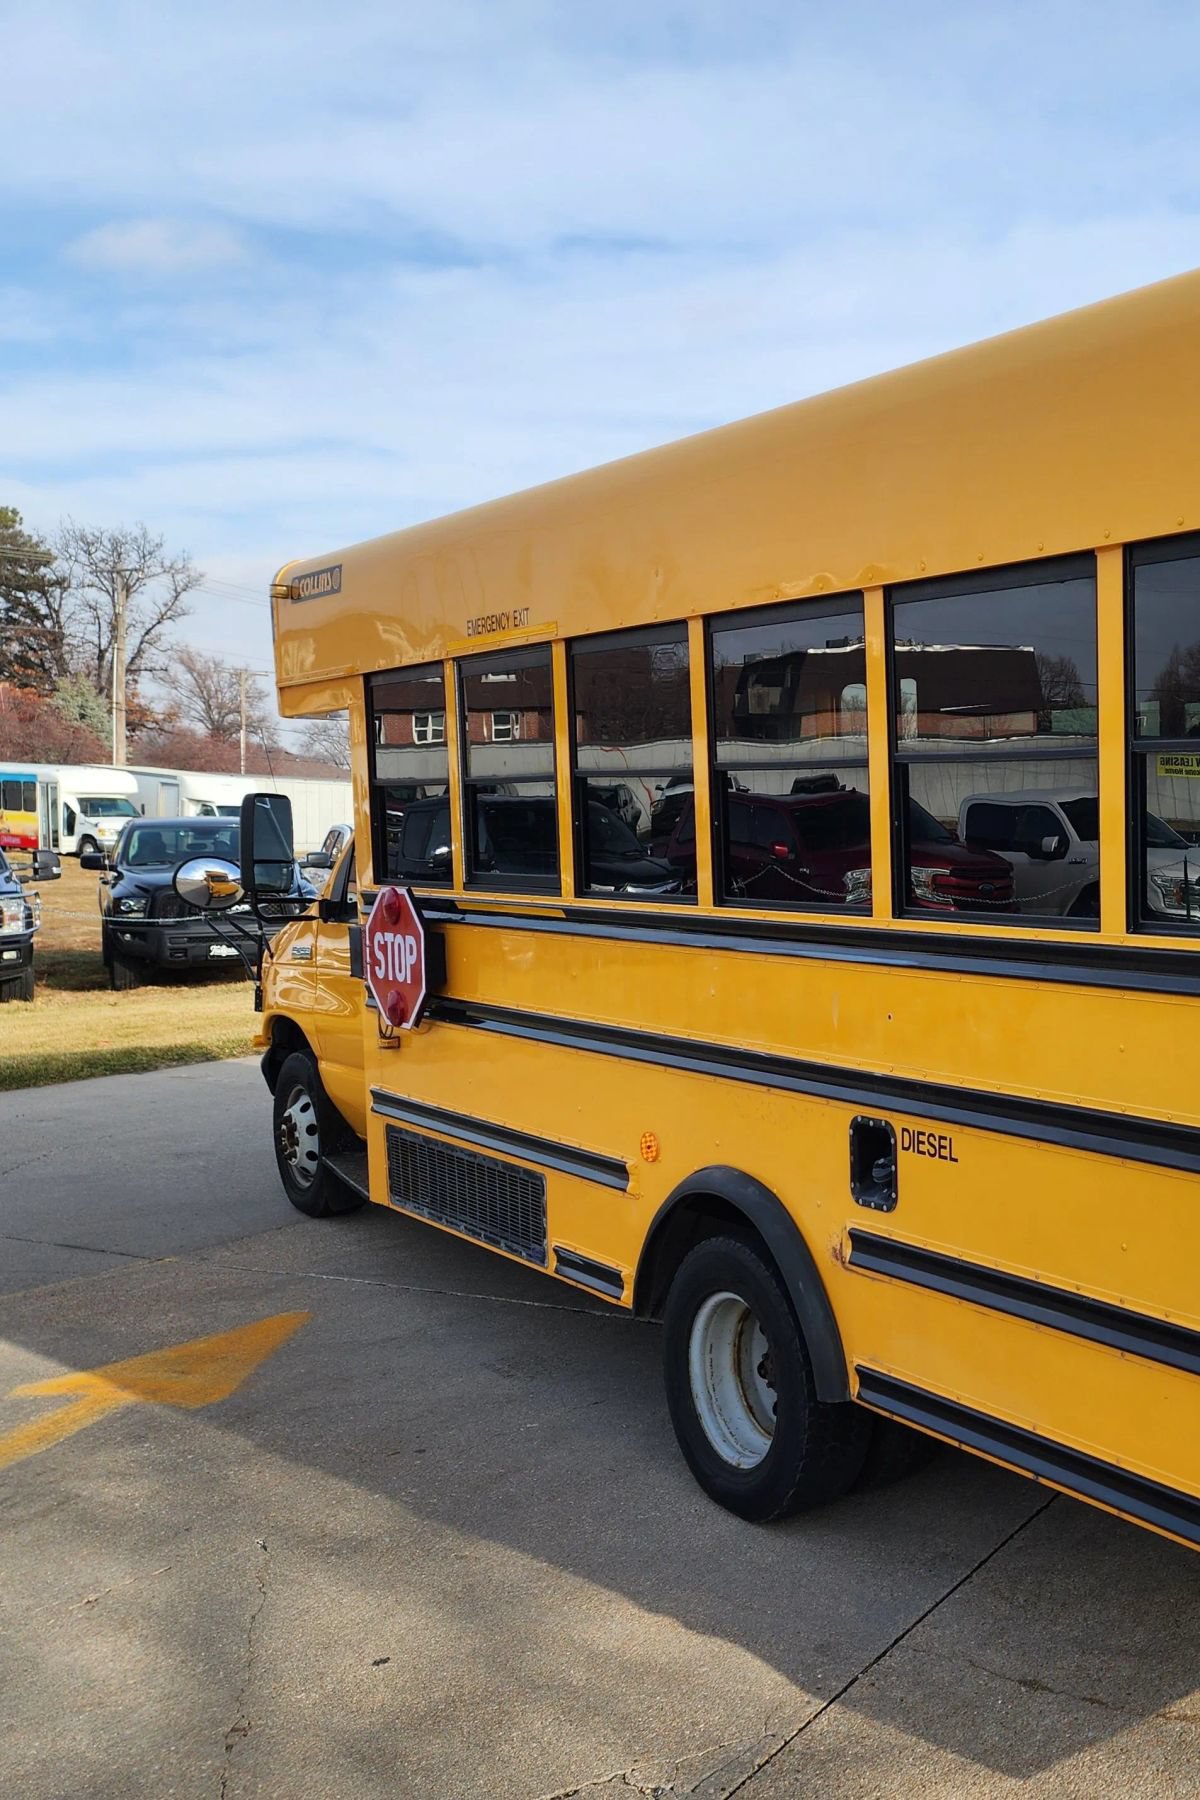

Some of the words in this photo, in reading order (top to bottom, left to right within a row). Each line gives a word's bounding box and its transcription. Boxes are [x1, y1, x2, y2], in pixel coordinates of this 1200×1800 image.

[466, 611, 512, 637] EMERGENCY
[513, 607, 531, 628] EXIT
[373, 931, 417, 984] STOP
[901, 1127, 959, 1163] DIESEL
